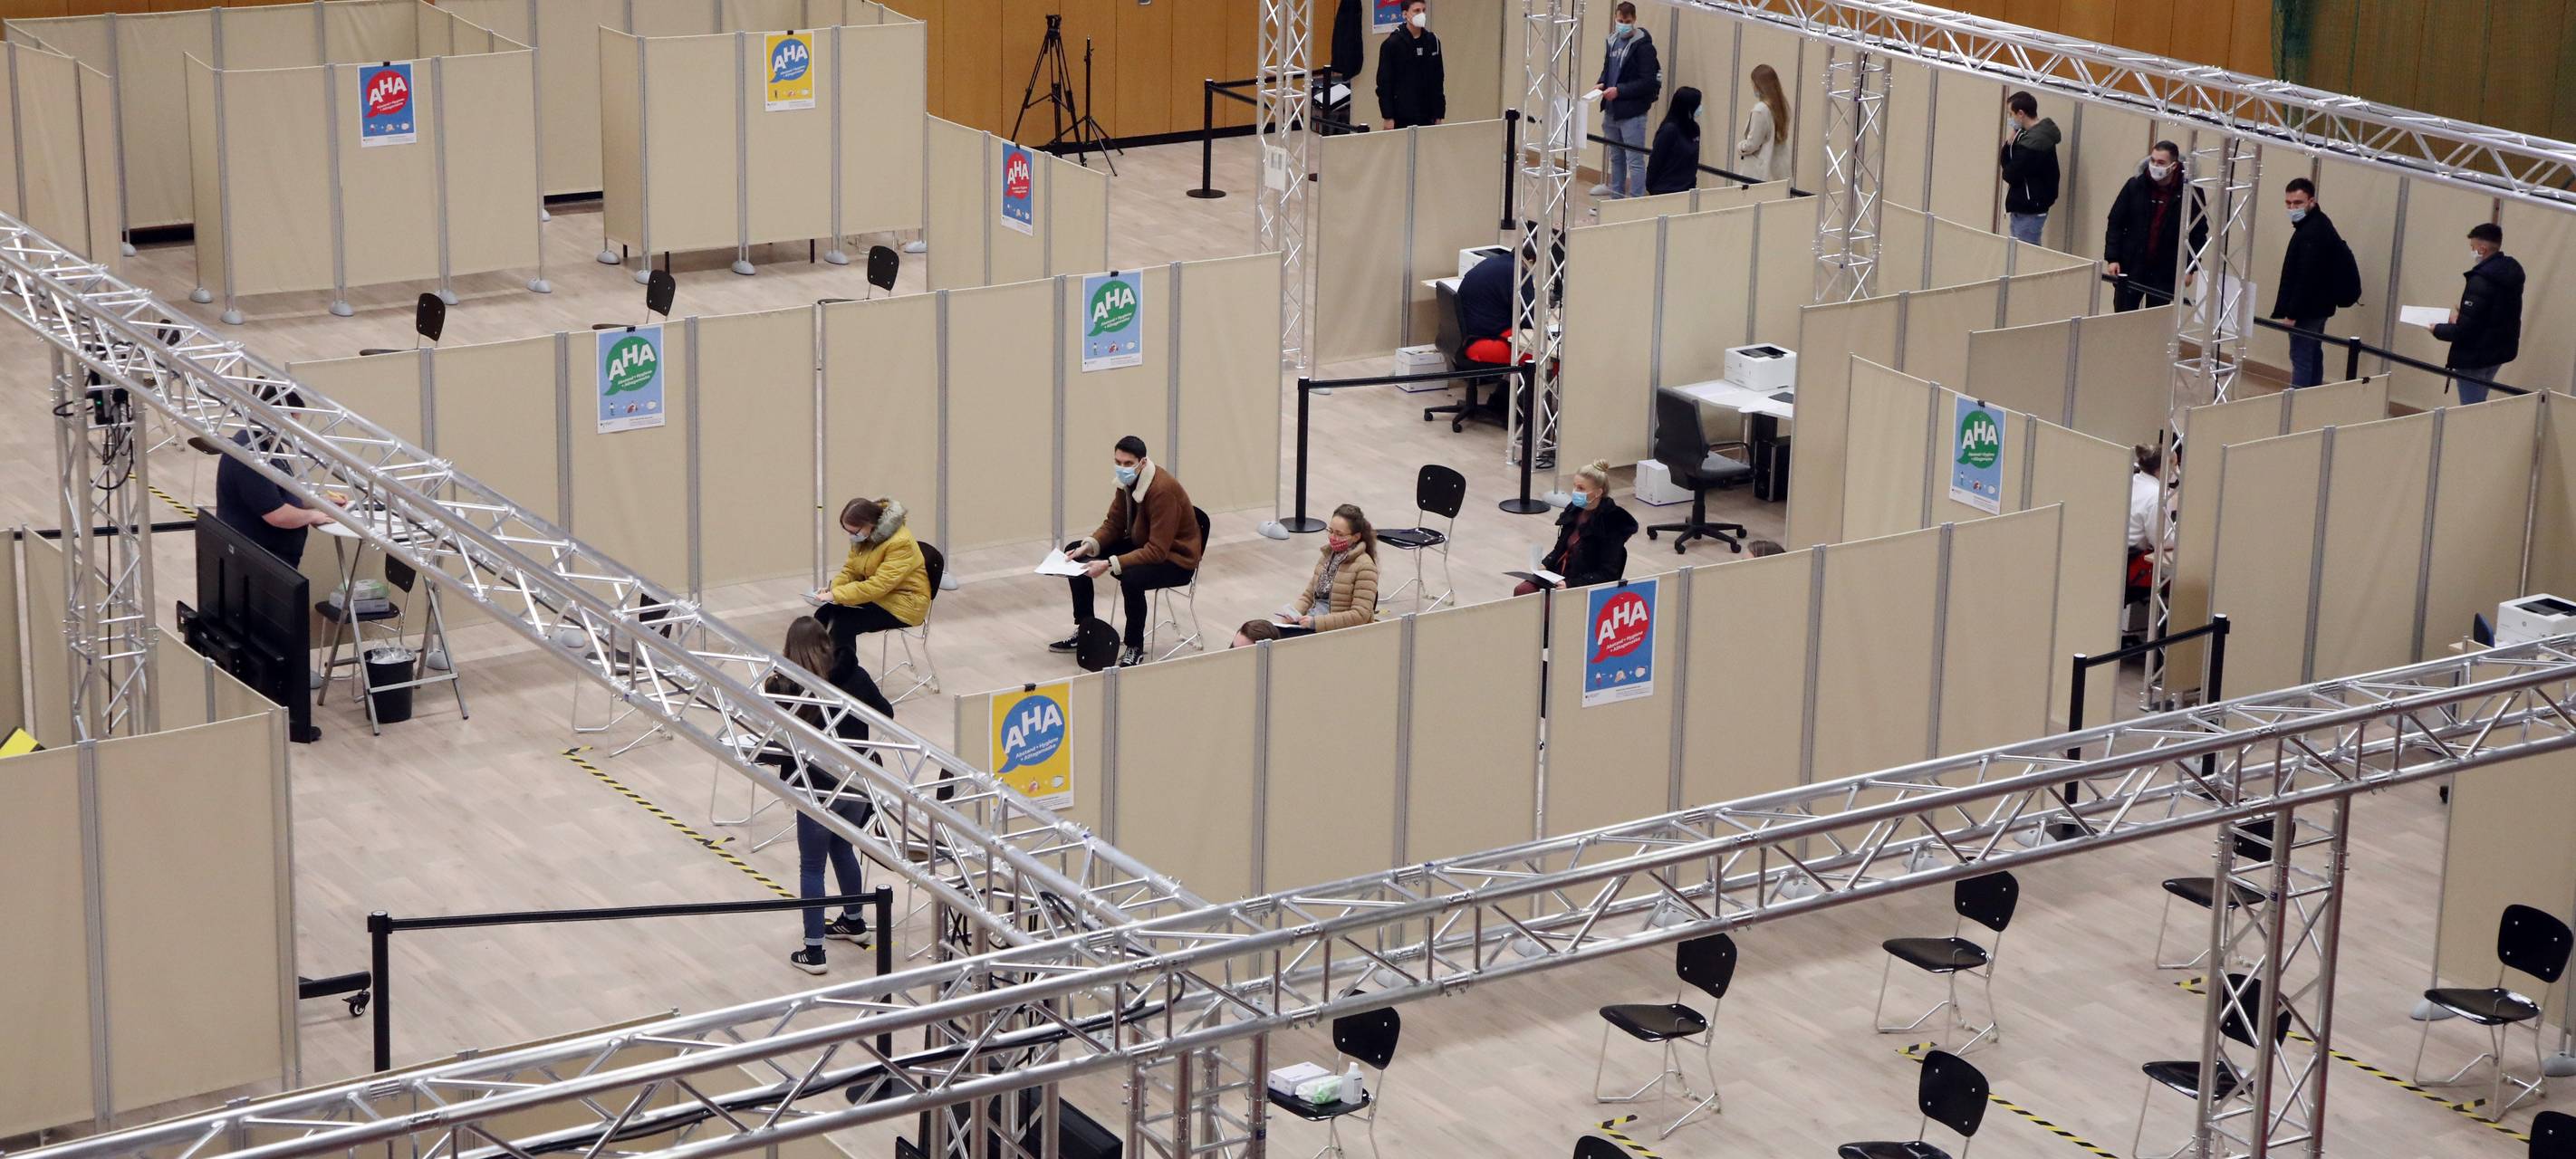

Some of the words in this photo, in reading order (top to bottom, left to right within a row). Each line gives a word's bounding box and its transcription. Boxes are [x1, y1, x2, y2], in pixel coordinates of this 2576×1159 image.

[774, 44, 808, 72] AHA
[369, 76, 408, 106] AHA
[1007, 160, 1030, 185] AHA
[1093, 287, 1136, 323] AHA
[609, 343, 656, 380] AHA
[1962, 420, 1998, 450] AHA
[1597, 600, 1648, 646] AHA
[1004, 704, 1062, 754] AHA
